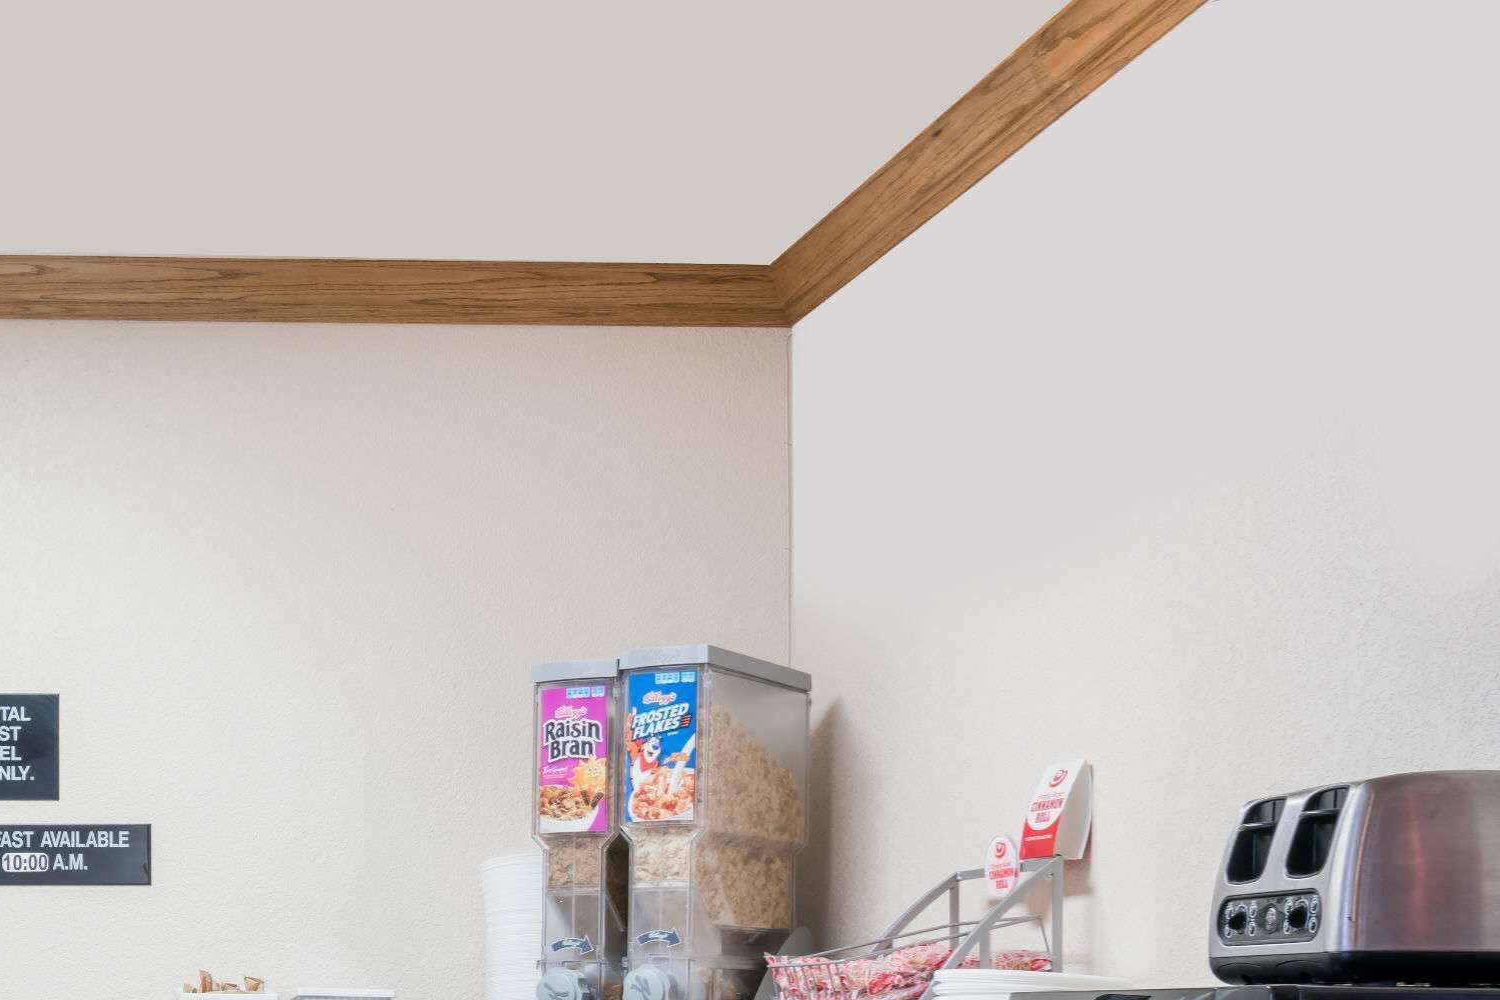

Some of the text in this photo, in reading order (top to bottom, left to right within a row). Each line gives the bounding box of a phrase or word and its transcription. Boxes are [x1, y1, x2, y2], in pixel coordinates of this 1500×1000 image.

[632, 702, 690, 728] FROSTED
[545, 720, 601, 743] Raisin
[632, 717, 681, 740] FLAKES
[550, 739, 594, 760] Bran
[40, 830, 130, 848] AVAILABLE
[53, 853, 88, 871] A.M.
